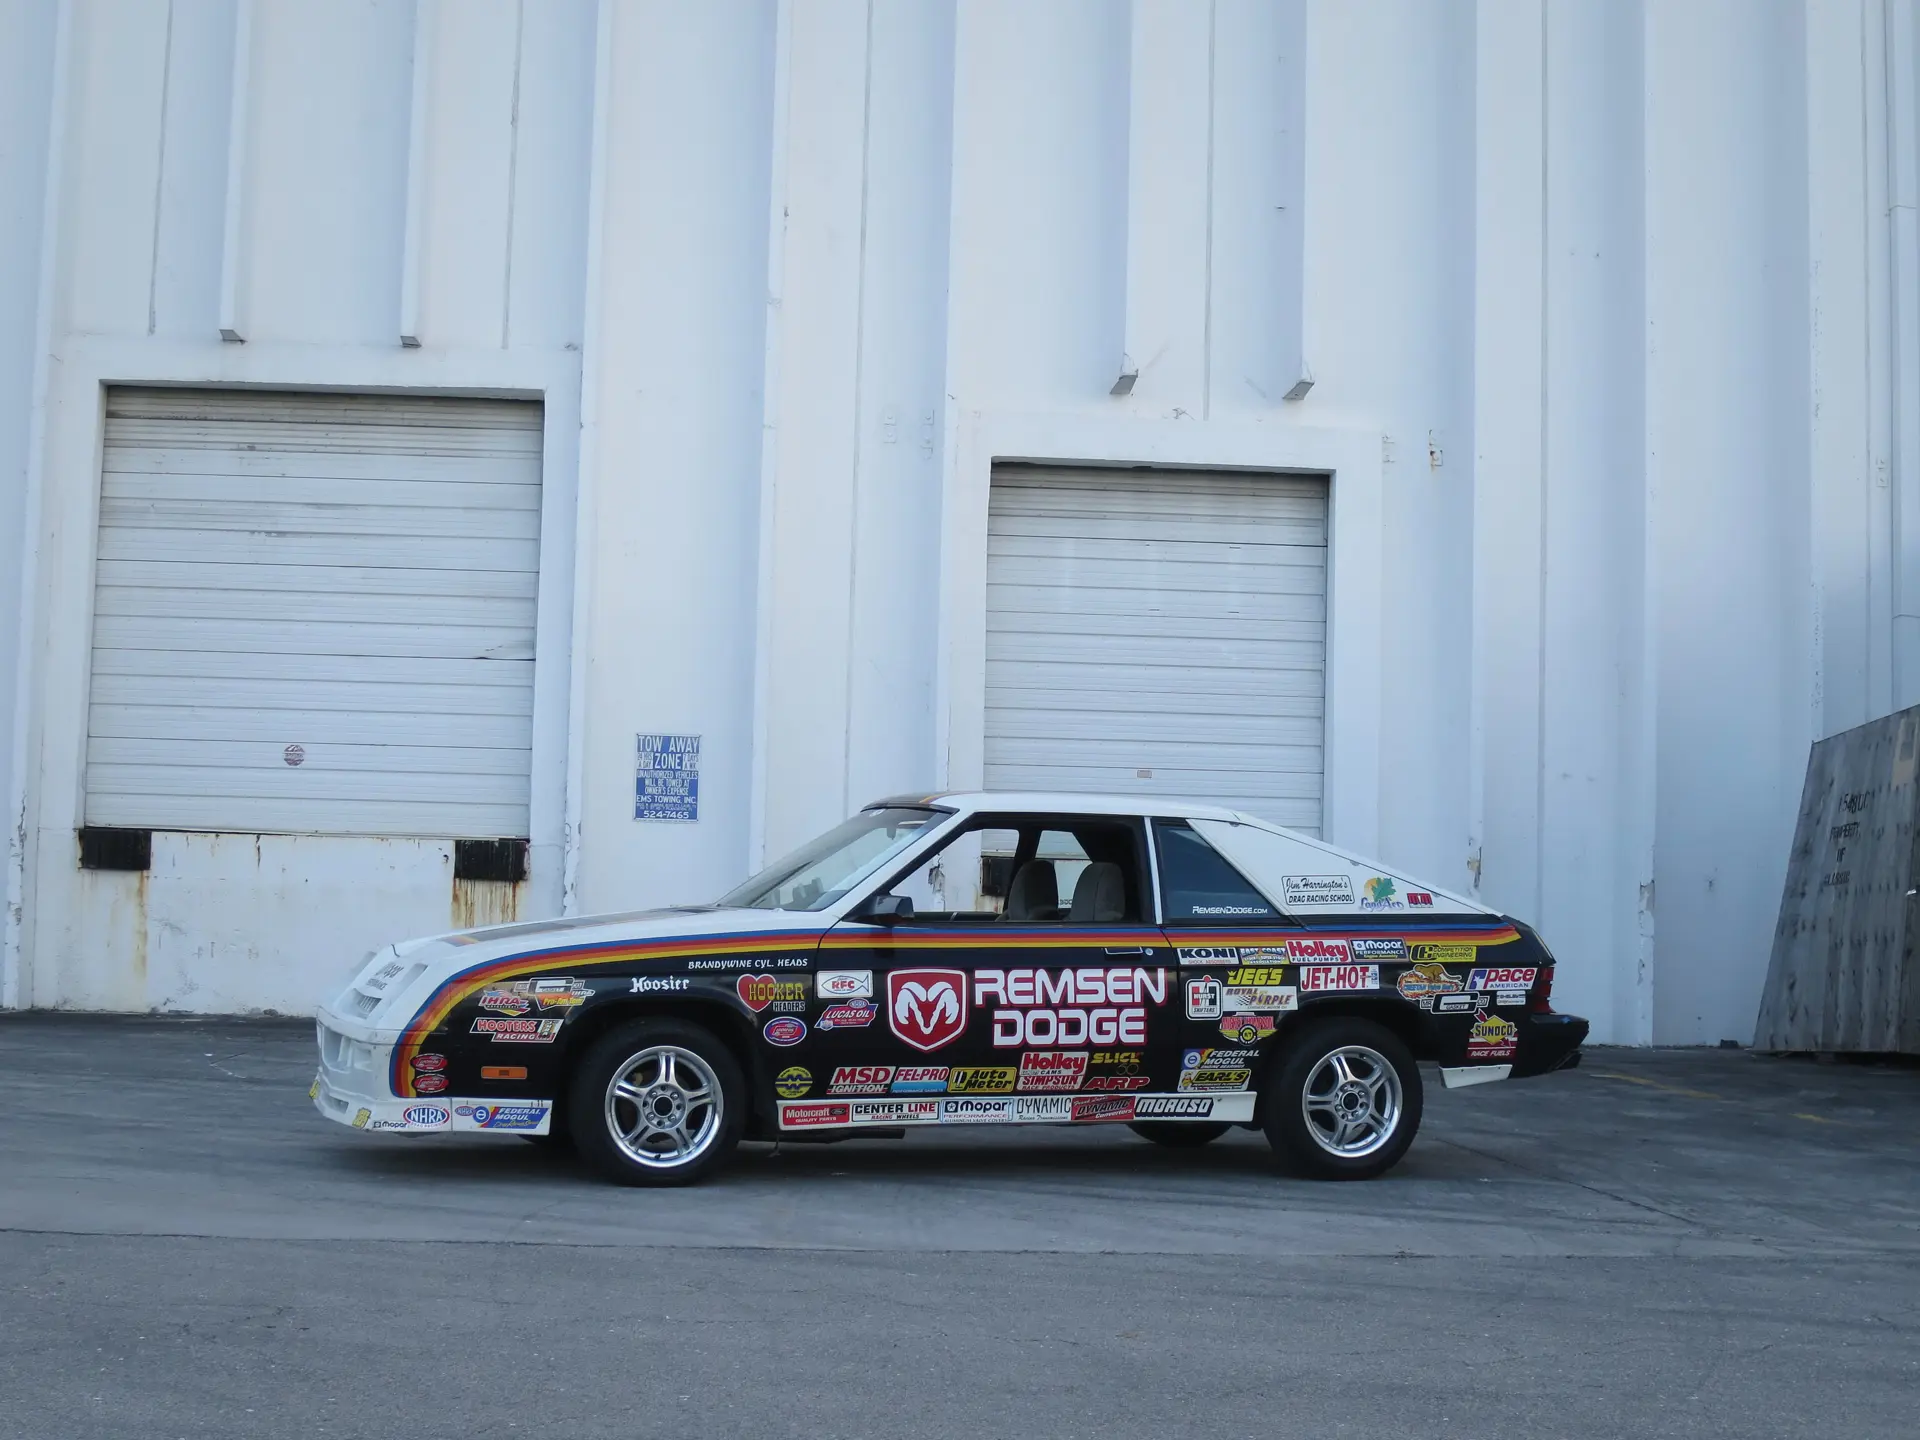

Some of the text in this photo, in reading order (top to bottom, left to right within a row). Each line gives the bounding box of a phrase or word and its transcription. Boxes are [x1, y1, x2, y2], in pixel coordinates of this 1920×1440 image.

[638, 735, 700, 753] TOW AWAY
[654, 753, 682, 769] ZONE
[637, 769, 699, 780] UNAUTHORIZED VEHICLES
[644, 778, 690, 788] WILL BE TOWED AT
[667, 787, 689, 796] EXPENSE
[636, 794, 652, 803] EMS
[643, 810, 690, 819] 524-7465
[1285, 876, 1349, 893] Jim Harrington's
[1288, 893, 1353, 904] DRAG RACING SCHOOL
[1180, 948, 1237, 959] KONI
[1240, 947, 1286, 957] EAST COAST
[1287, 940, 1349, 963] Holley
[688, 959, 752, 970] BRANDYWINE
[777, 958, 808, 968] HEADS
[1227, 968, 1283, 985] JEG'S
[1301, 966, 1370, 990] JET-HOT
[1483, 968, 1535, 989] pace
[629, 974, 690, 993] Hoosier
[831, 980, 855, 990] RFC
[974, 967, 1166, 1005] REMSEN
[748, 981, 805, 1001] HOOKER
[1225, 987, 1258, 996] ROYAL
[481, 996, 521, 1006] IHRA
[1248, 994, 1293, 1006] PURPLE
[772, 1001, 806, 1012] HEADERS
[826, 1009, 870, 1019] LUCAS OIL
[477, 1019, 537, 1034] HOOTERS
[993, 1008, 1145, 1046] DODGE
[1475, 1025, 1513, 1037] SUNOCO
[495, 1032, 536, 1041] RACING
[1091, 1051, 1142, 1064] SLICK
[1209, 1049, 1260, 1058] FEDERAL
[1022, 1052, 1087, 1075] Holley
[1204, 1057, 1245, 1066] MOGUL
[833, 1067, 891, 1085] MSD
[893, 1067, 949, 1082] FEL-PRO
[969, 1069, 1008, 1080] Auto
[1022, 1075, 1080, 1086] SIMPSON
[1194, 1071, 1247, 1083] EARL'S
[831, 1084, 885, 1094] IGNITION
[966, 1079, 1013, 1090] Meter
[1082, 1076, 1151, 1091] ARP
[498, 1107, 541, 1115] FEDERAL
[854, 1102, 936, 1114] CENTER LINE
[1016, 1097, 1072, 1114] DYNAMIC
[1076, 1098, 1131, 1117] DYNAMIC
[1135, 1098, 1214, 1113] MOROSO
[410, 1108, 443, 1123] NHRA
[785, 1107, 830, 1119] Motorcraft
[1095, 1108, 1133, 1119] Converters
